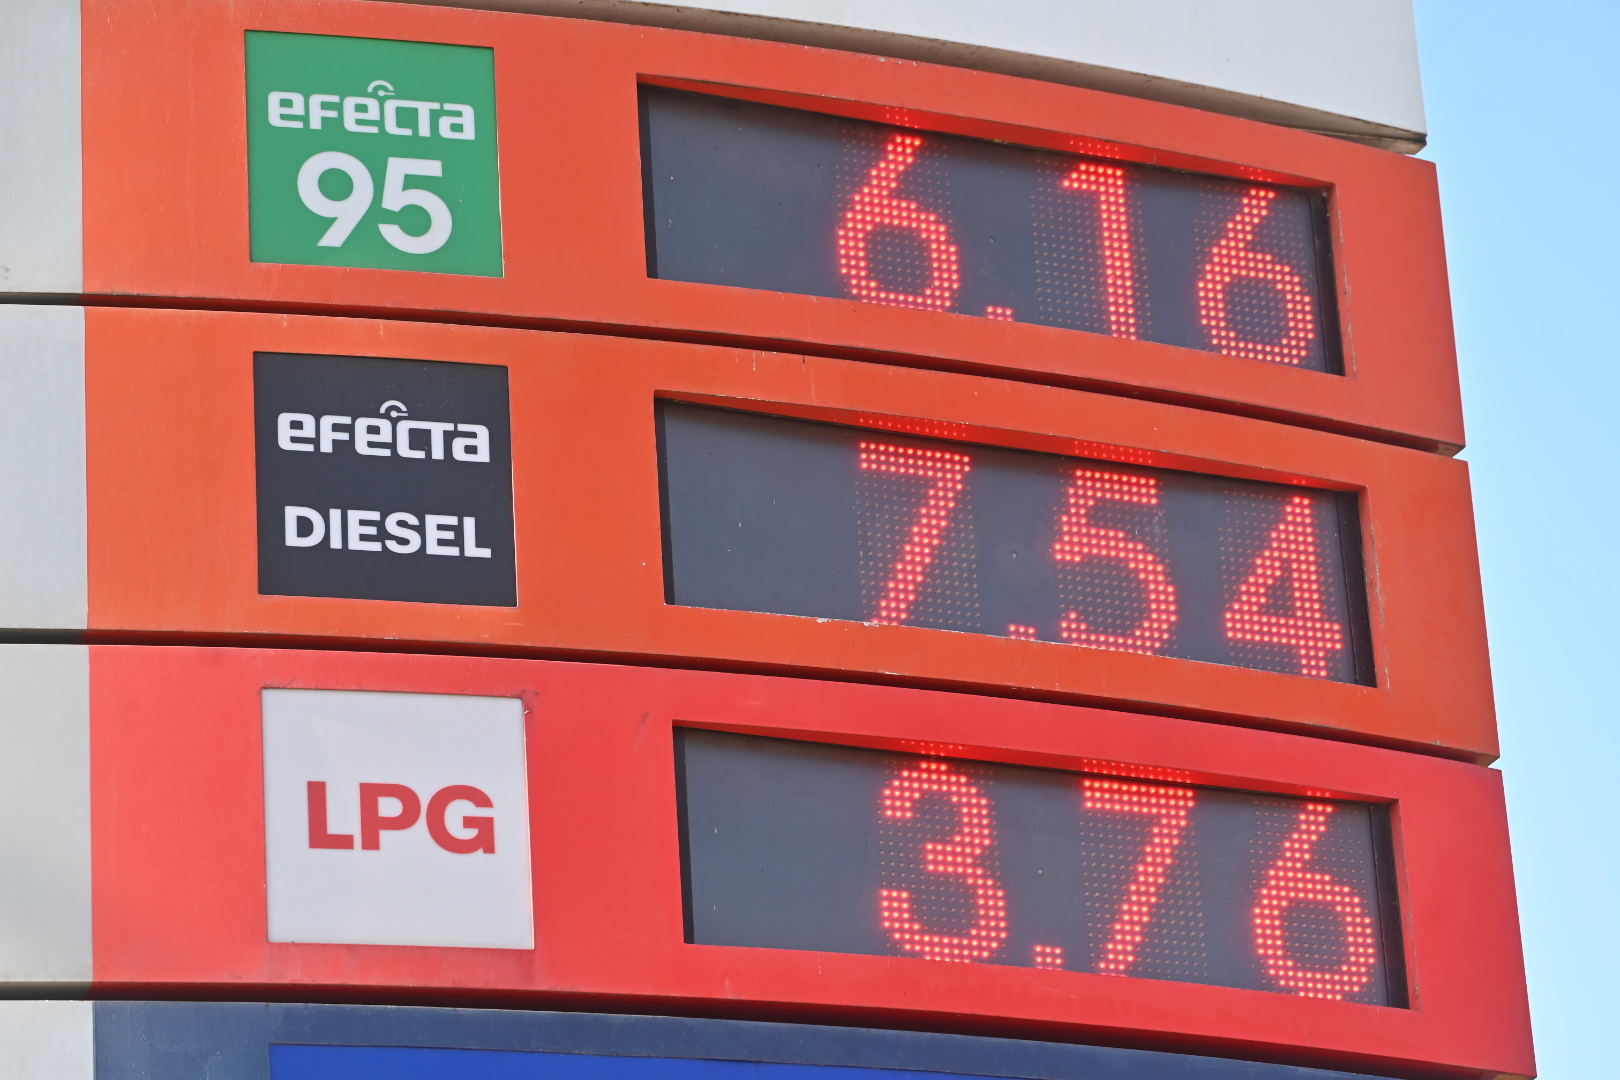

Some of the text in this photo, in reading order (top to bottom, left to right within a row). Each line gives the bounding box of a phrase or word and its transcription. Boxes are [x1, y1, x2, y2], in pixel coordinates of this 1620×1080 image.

[297, 151, 453, 254] 95
[838, 136, 1315, 364] 6.16
[284, 505, 492, 558] DIESEL
[859, 441, 1343, 678] 7.54
[308, 780, 496, 854] LPG
[880, 762, 1376, 999] 3.76
